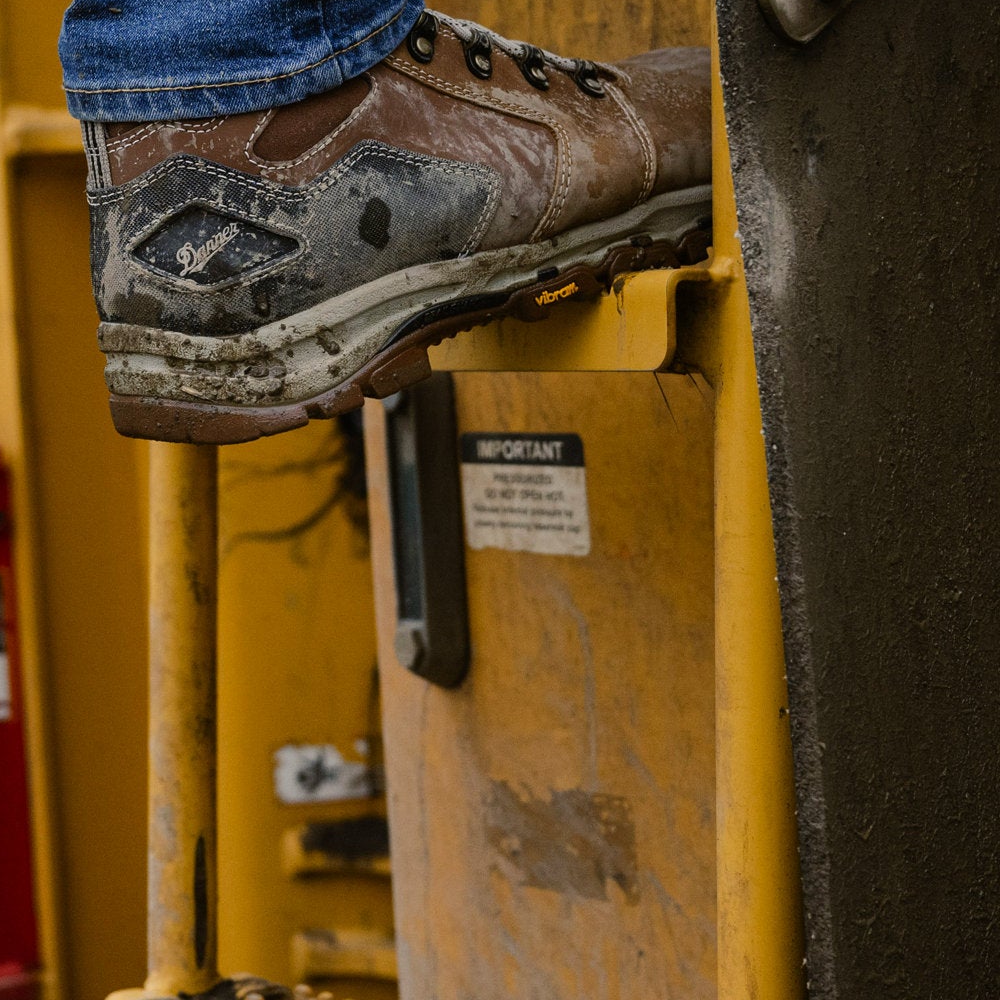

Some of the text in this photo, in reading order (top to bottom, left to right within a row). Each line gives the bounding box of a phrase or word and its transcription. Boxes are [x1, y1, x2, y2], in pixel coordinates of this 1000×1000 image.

[175, 222, 240, 276] Danner
[535, 282, 579, 306] vibram
[477, 440, 563, 460] IMPORTANT
